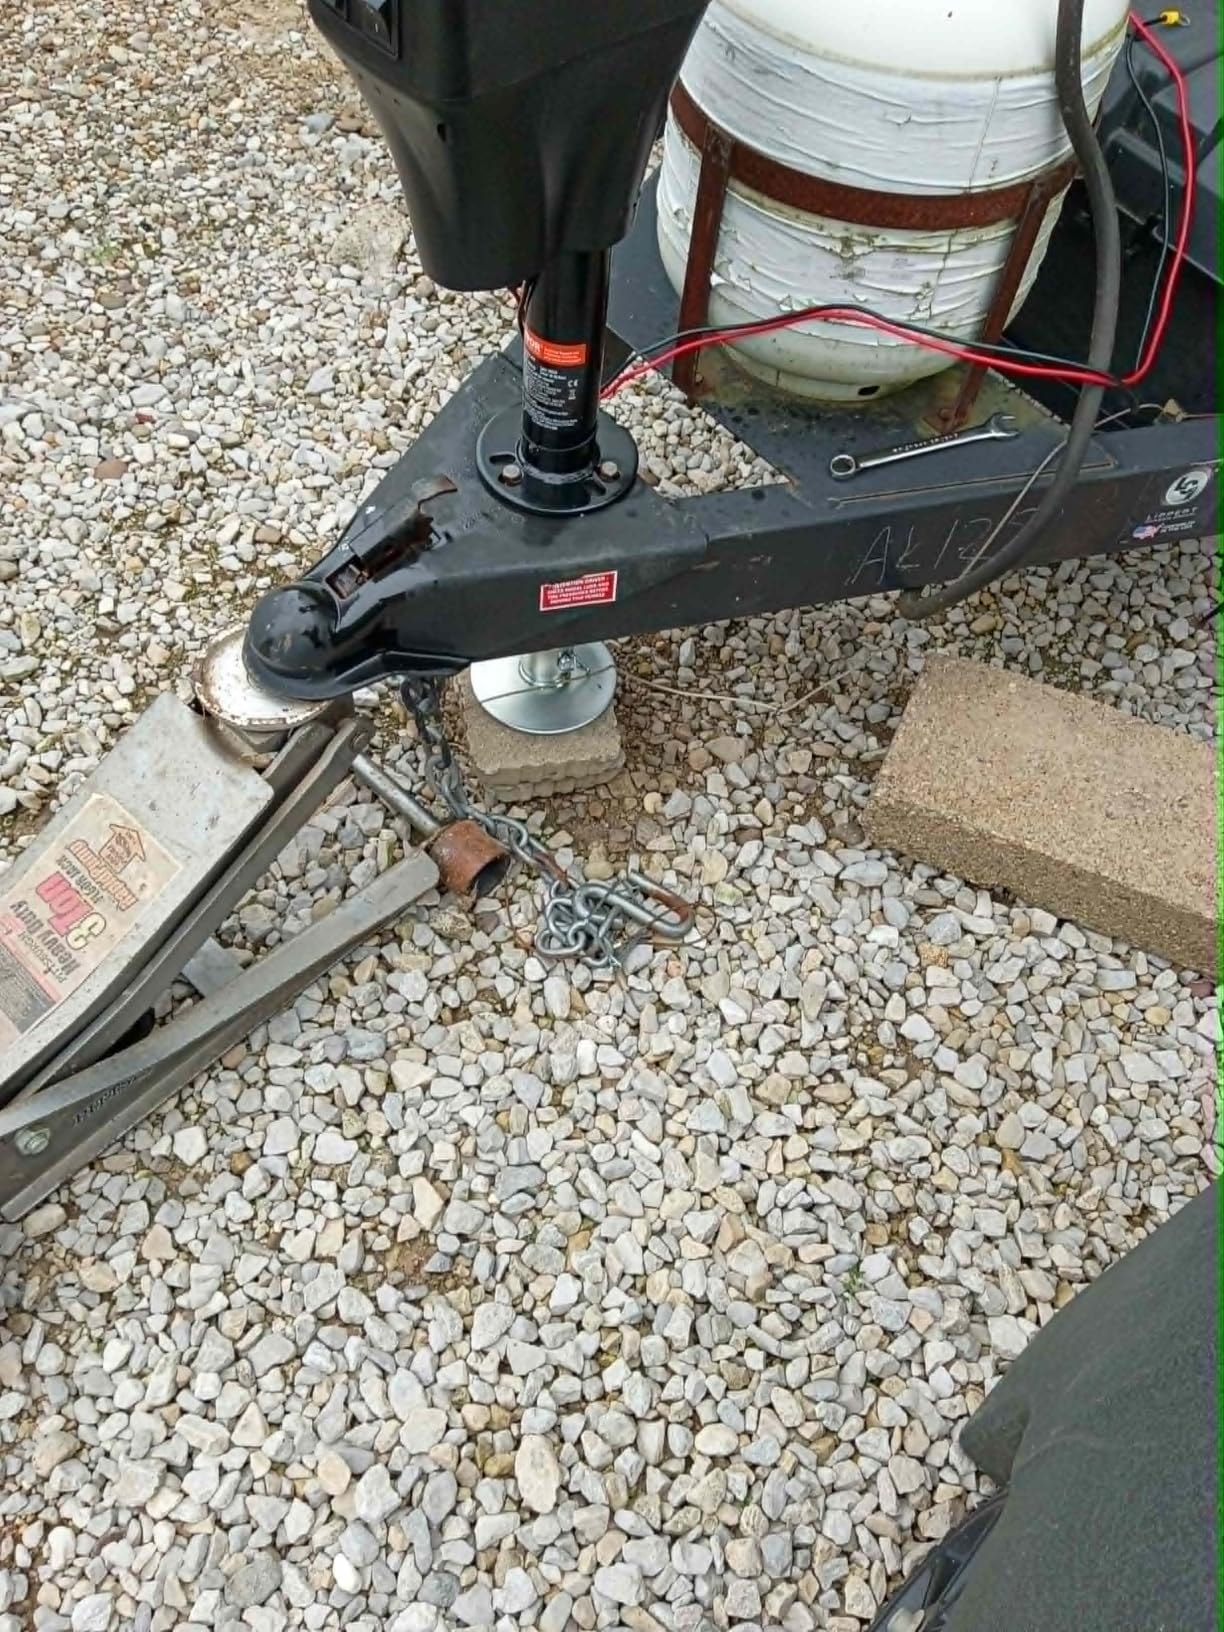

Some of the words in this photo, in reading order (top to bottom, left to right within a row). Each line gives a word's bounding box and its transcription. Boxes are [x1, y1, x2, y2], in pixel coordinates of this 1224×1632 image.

[56, 856, 82, 880] JACK
[10, 901, 44, 934] Duty
[18, 931, 67, 983] PITTSBURGH
[36, 930, 80, 975] Heavy
